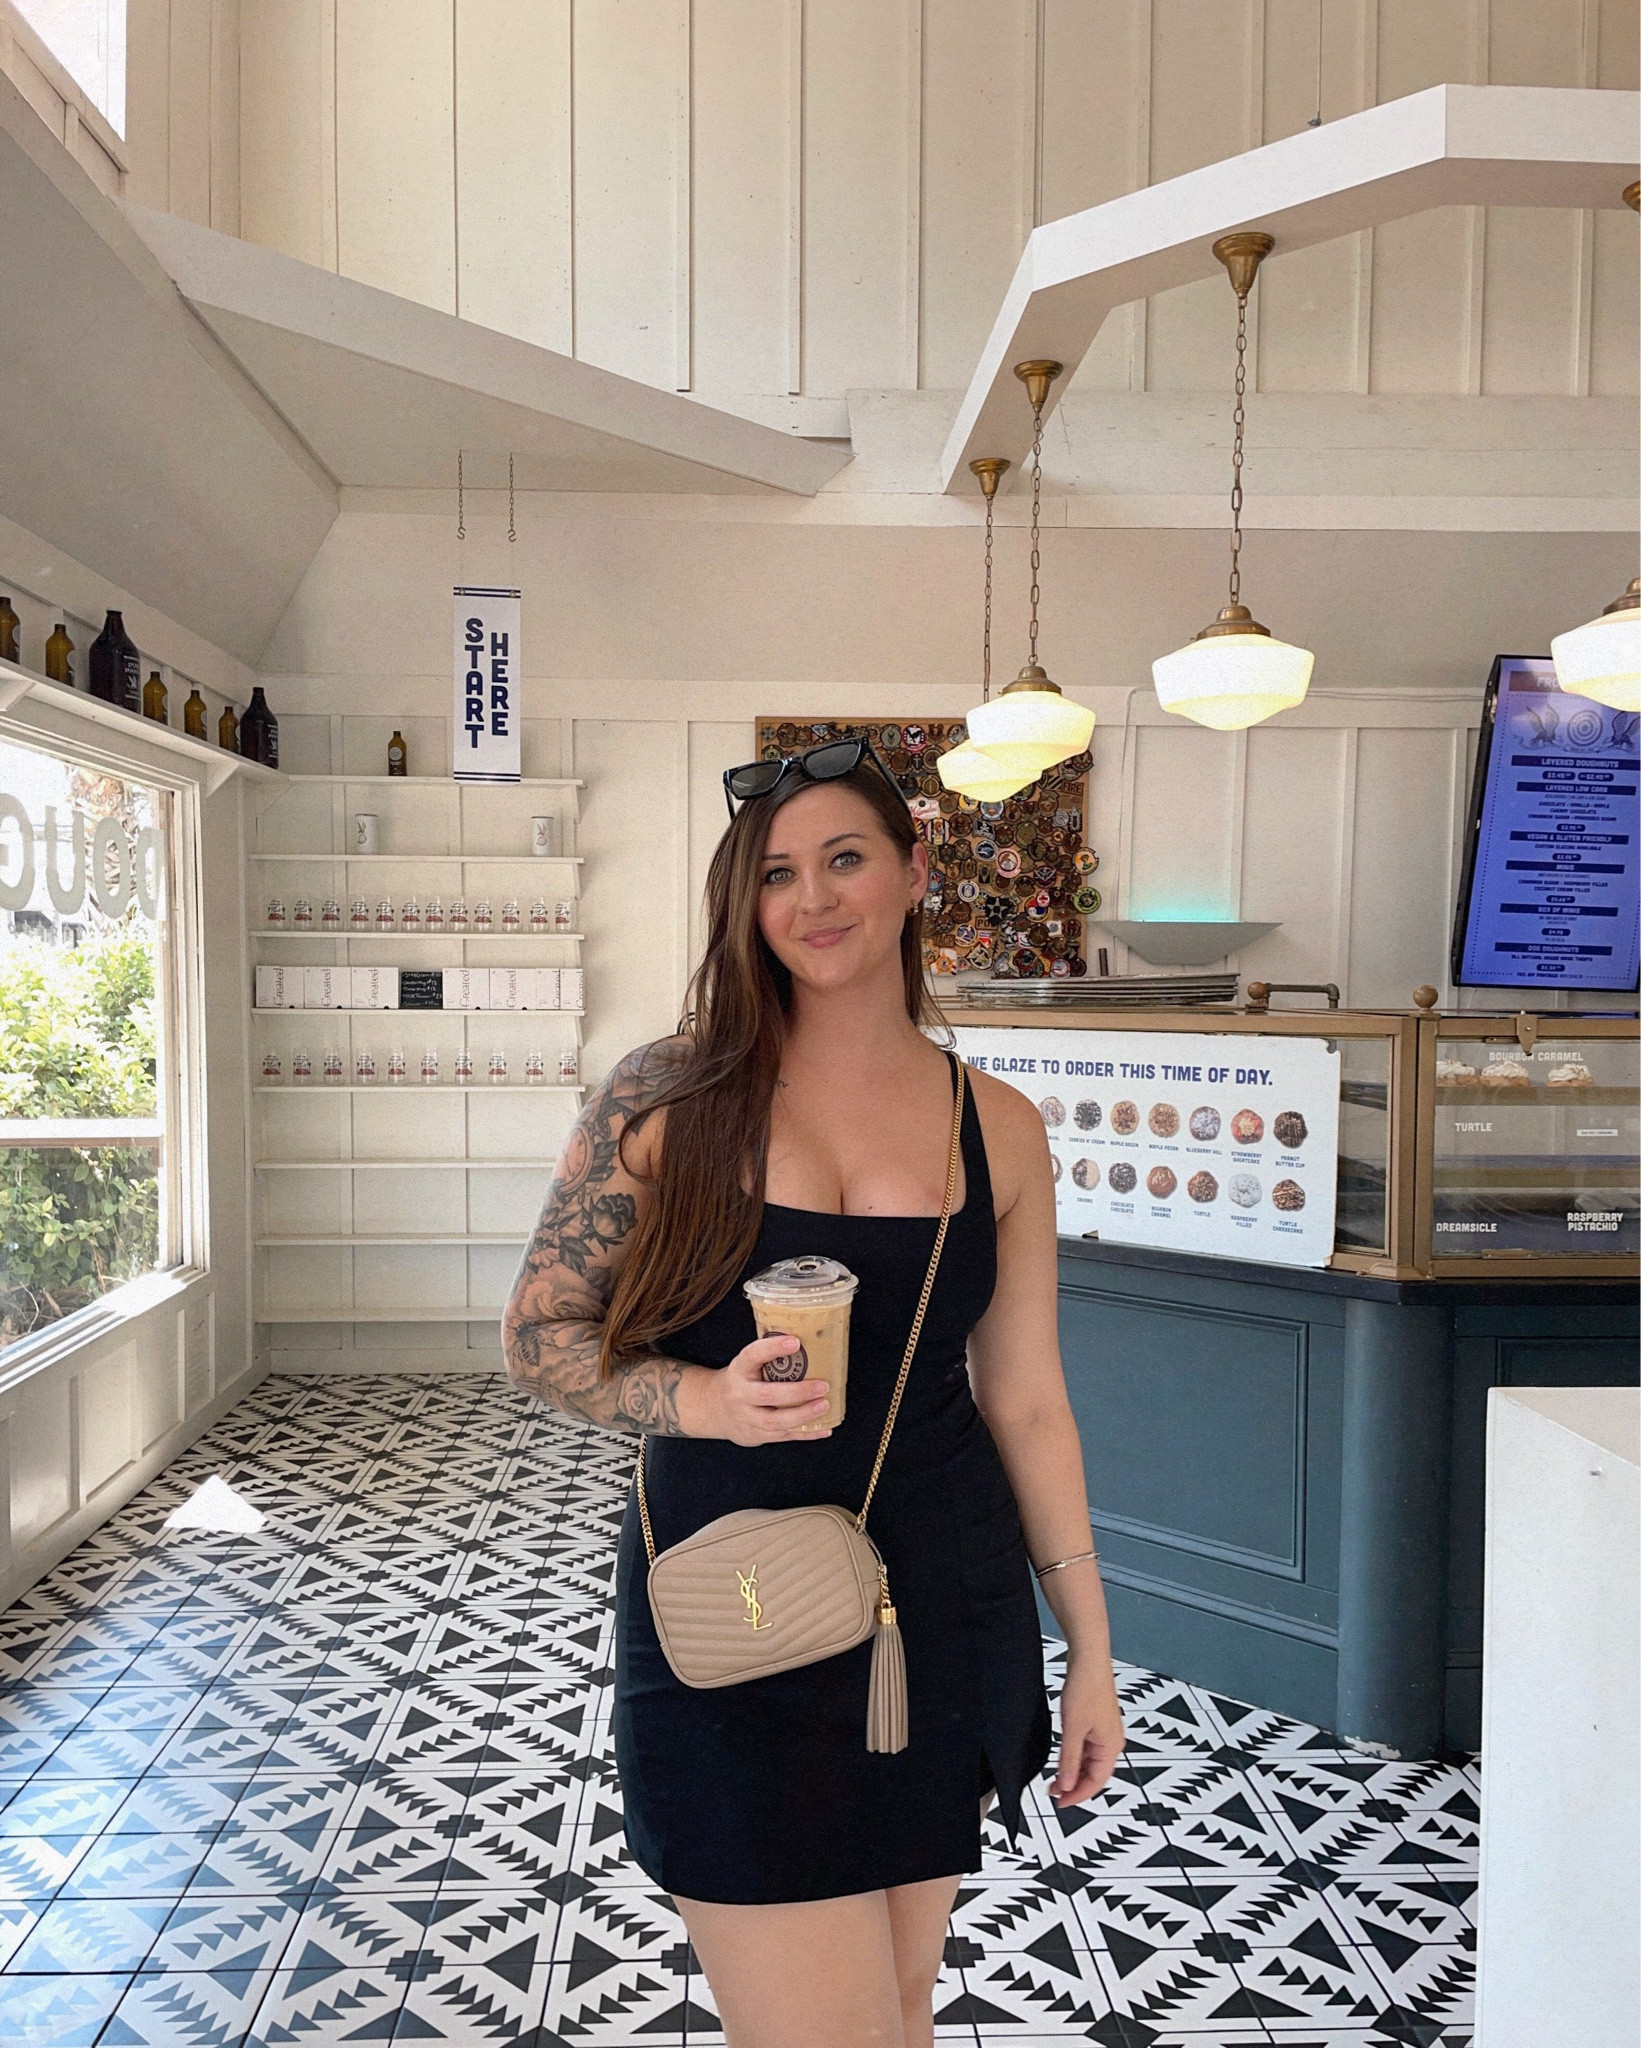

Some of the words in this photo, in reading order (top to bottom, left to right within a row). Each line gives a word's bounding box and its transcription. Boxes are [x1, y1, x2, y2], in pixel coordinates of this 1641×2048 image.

[464, 617, 485, 749] START
[490, 632, 510, 737] HERE
[1541, 758, 1575, 766] LAYERED
[1575, 759, 1620, 768] DOUGHNUTS
[1063, 781, 1082, 793] FIRE
[1538, 1052, 1583, 1062] CARAMEL
[966, 1056, 988, 1071] WE
[992, 1056, 1036, 1074] GLAZE
[1042, 1059, 1060, 1075] TO
[1065, 1061, 1114, 1078] ORDER
[1120, 1063, 1156, 1080] THIS
[1161, 1065, 1202, 1082] TIME
[1208, 1067, 1230, 1083] OF
[1236, 1068, 1273, 1086] DAY.
[1454, 1122, 1493, 1132] TURTLE
[1233, 1157, 1260, 1165] SHORTCAKE
[1151, 1211, 1171, 1219] CARAMEL
[1567, 1212, 1624, 1222] RASPBERRY
[1272, 1226, 1303, 1234] CHEESECAKE
[1436, 1222, 1498, 1233] DREAMSICLE
[1568, 1221, 1619, 1232] PISTACHIO
[767, 1362, 802, 1382] OUGHNUTS
[736, 1564, 774, 1631] YSL
